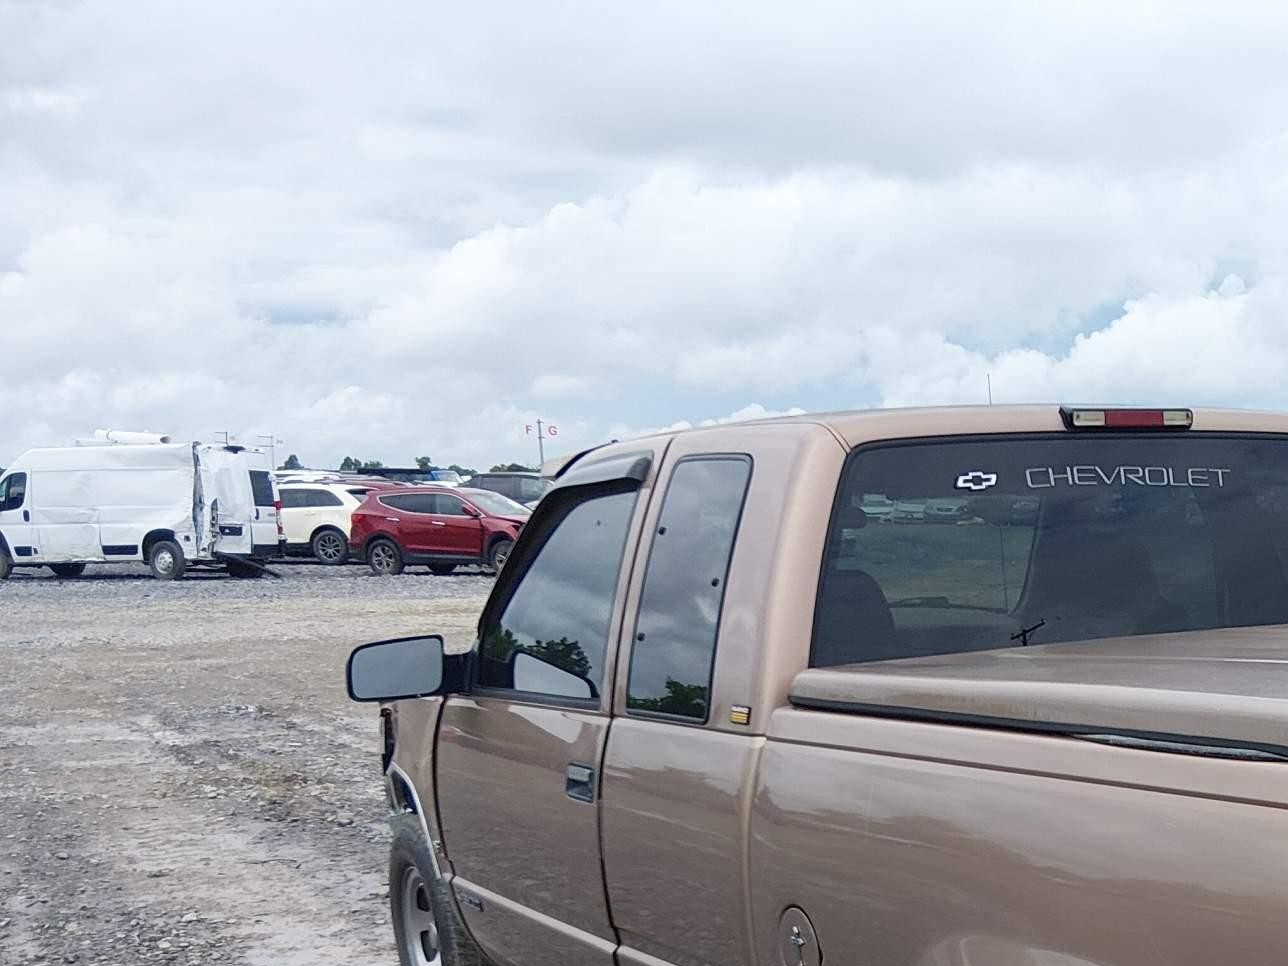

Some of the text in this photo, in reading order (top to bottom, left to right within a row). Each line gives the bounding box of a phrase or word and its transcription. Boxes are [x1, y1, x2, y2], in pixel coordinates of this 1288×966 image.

[525, 424, 533, 435] F
[548, 425, 558, 436] G
[1025, 465, 1231, 488] CHEVROLET
